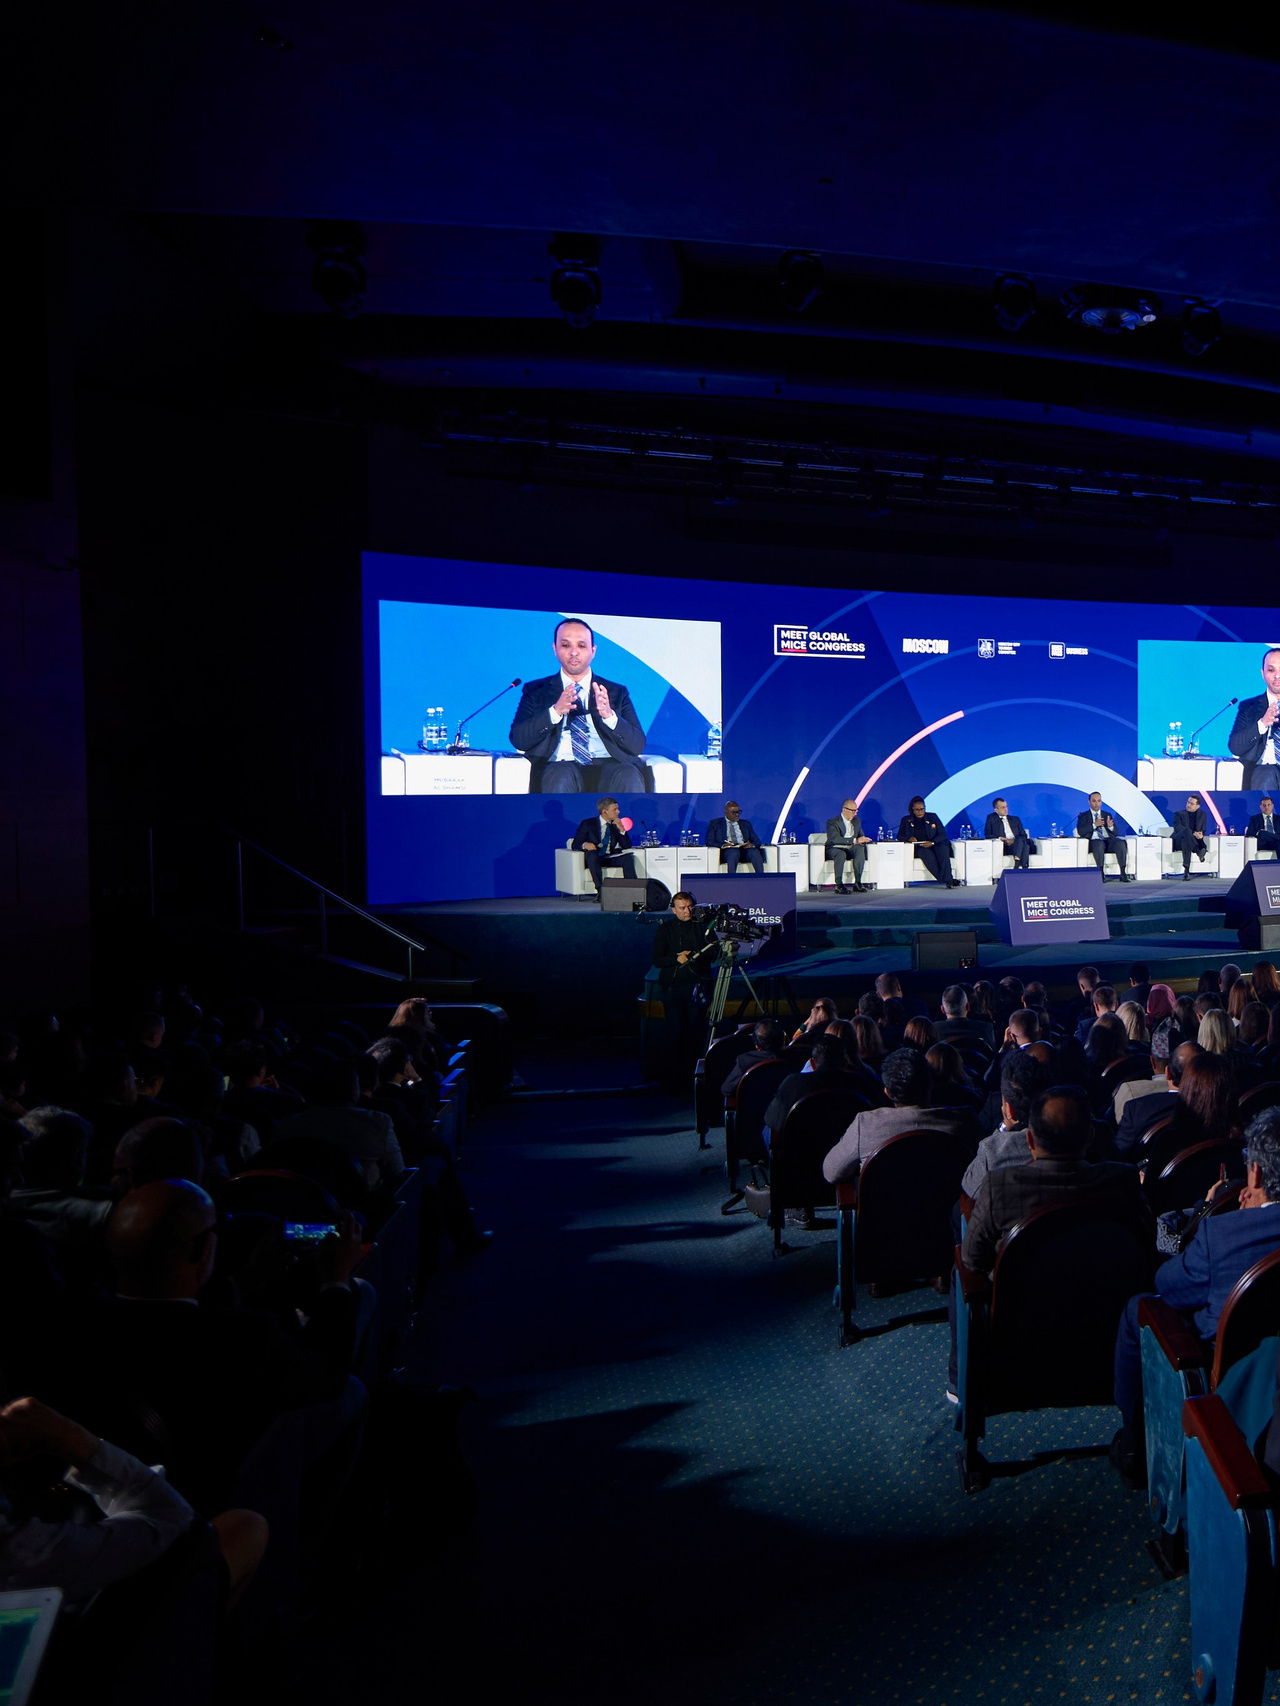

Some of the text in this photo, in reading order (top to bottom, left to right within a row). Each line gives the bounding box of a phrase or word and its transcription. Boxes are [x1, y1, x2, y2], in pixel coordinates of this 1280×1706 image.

[781, 630, 850, 642] MEET GLOBAL
[781, 640, 866, 652] MICE CONGRESS
[902, 638, 949, 654] MOSCOW
[1026, 899, 1082, 908] MEET GLOBAL
[1050, 907, 1094, 915] CONGRESS
